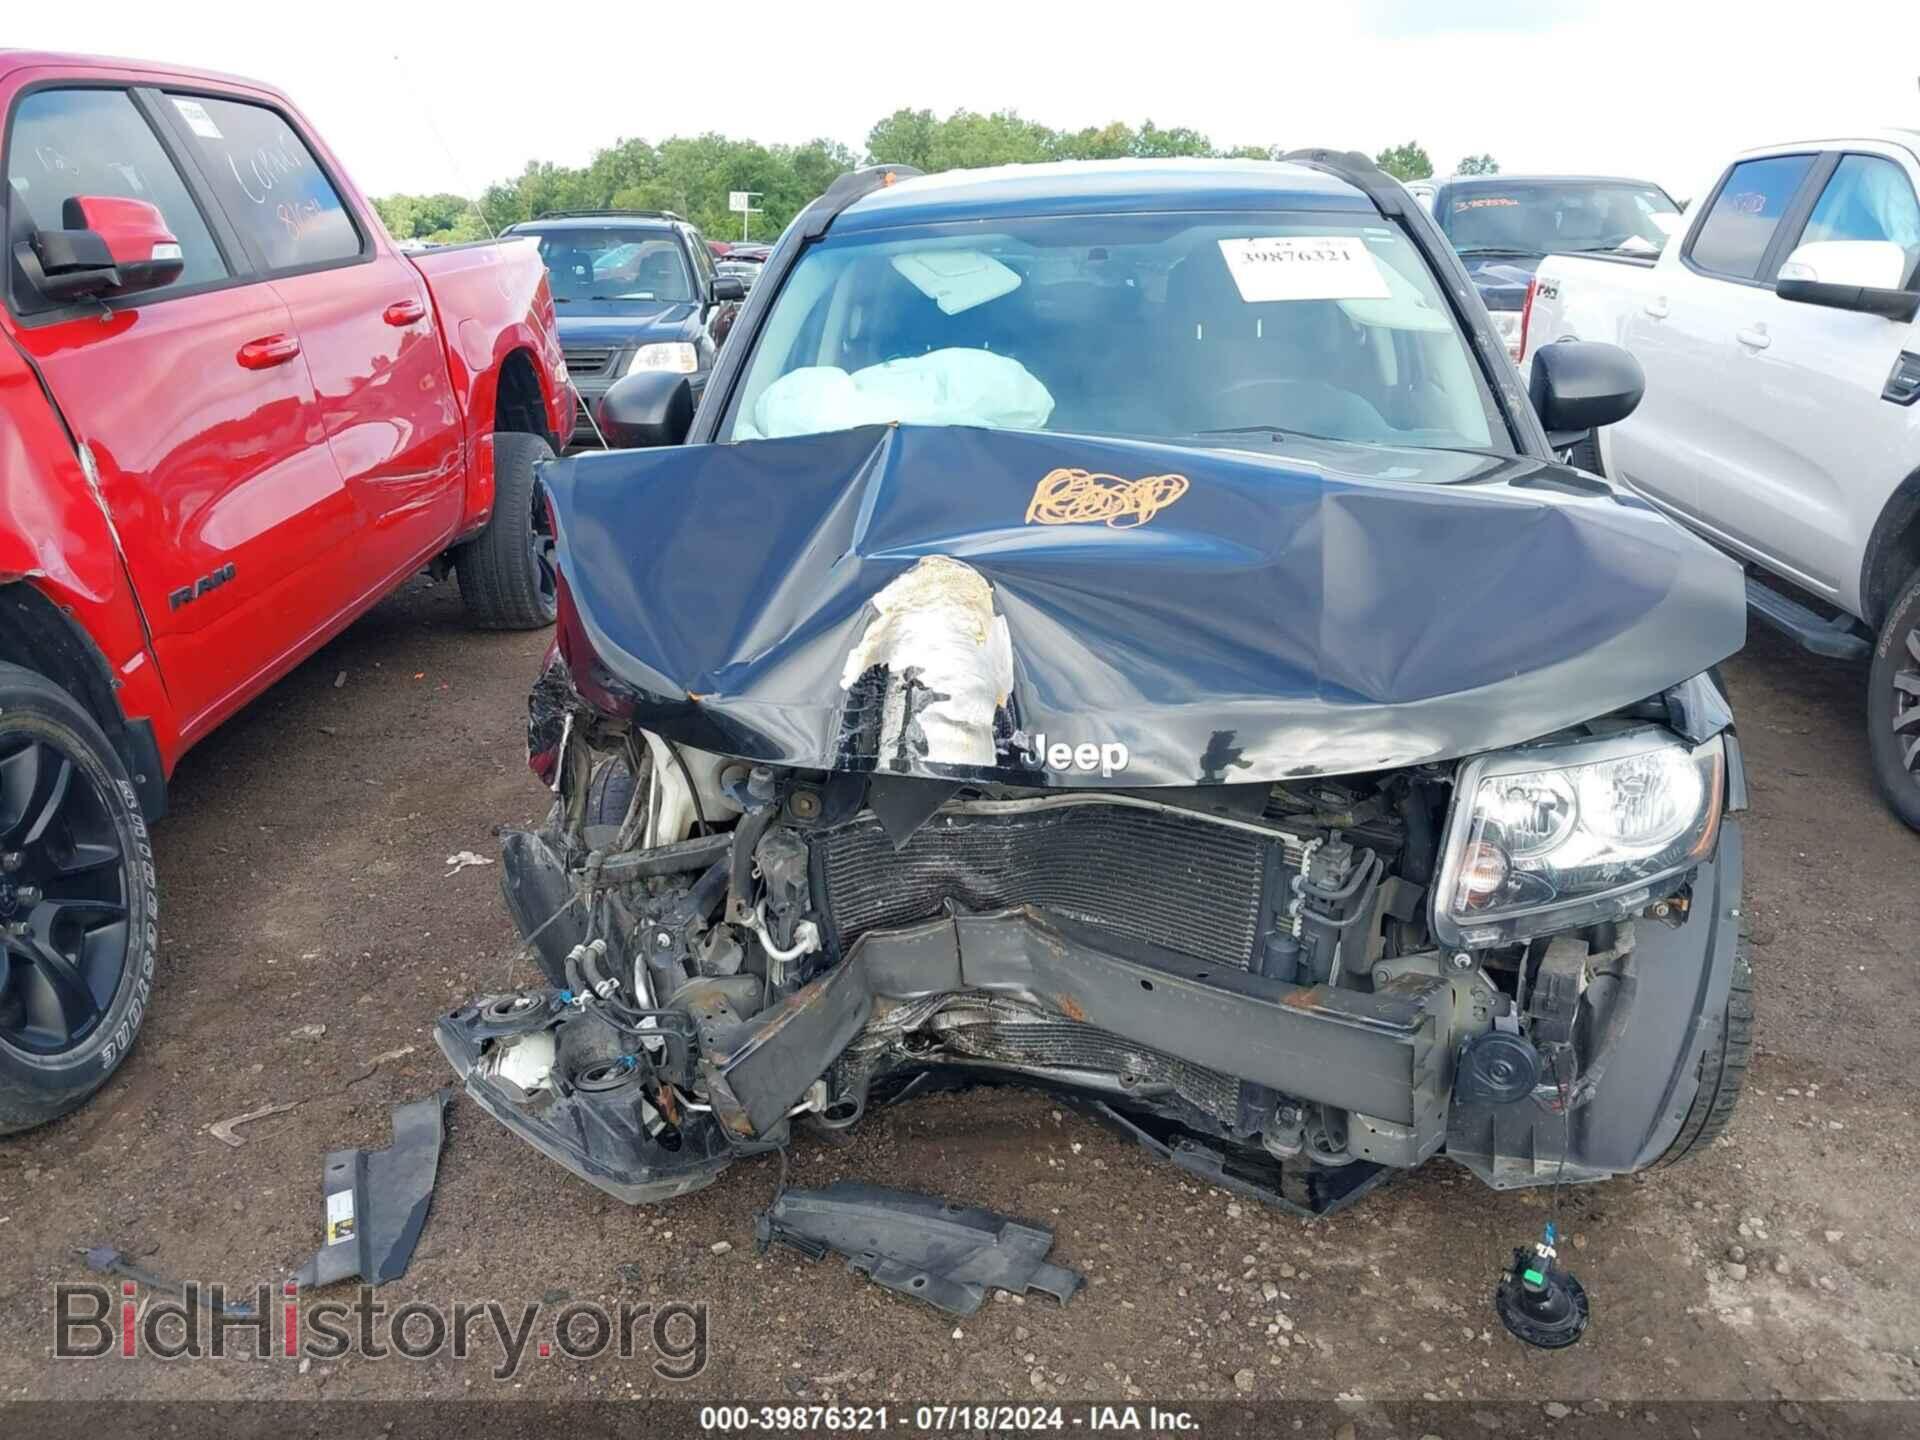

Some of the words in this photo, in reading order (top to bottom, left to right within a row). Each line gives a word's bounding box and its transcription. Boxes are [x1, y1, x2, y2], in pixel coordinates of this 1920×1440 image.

[1242, 250, 1351, 264] 39876321
[167, 561, 236, 611] RAM
[1020, 733, 1128, 777] Jeep
